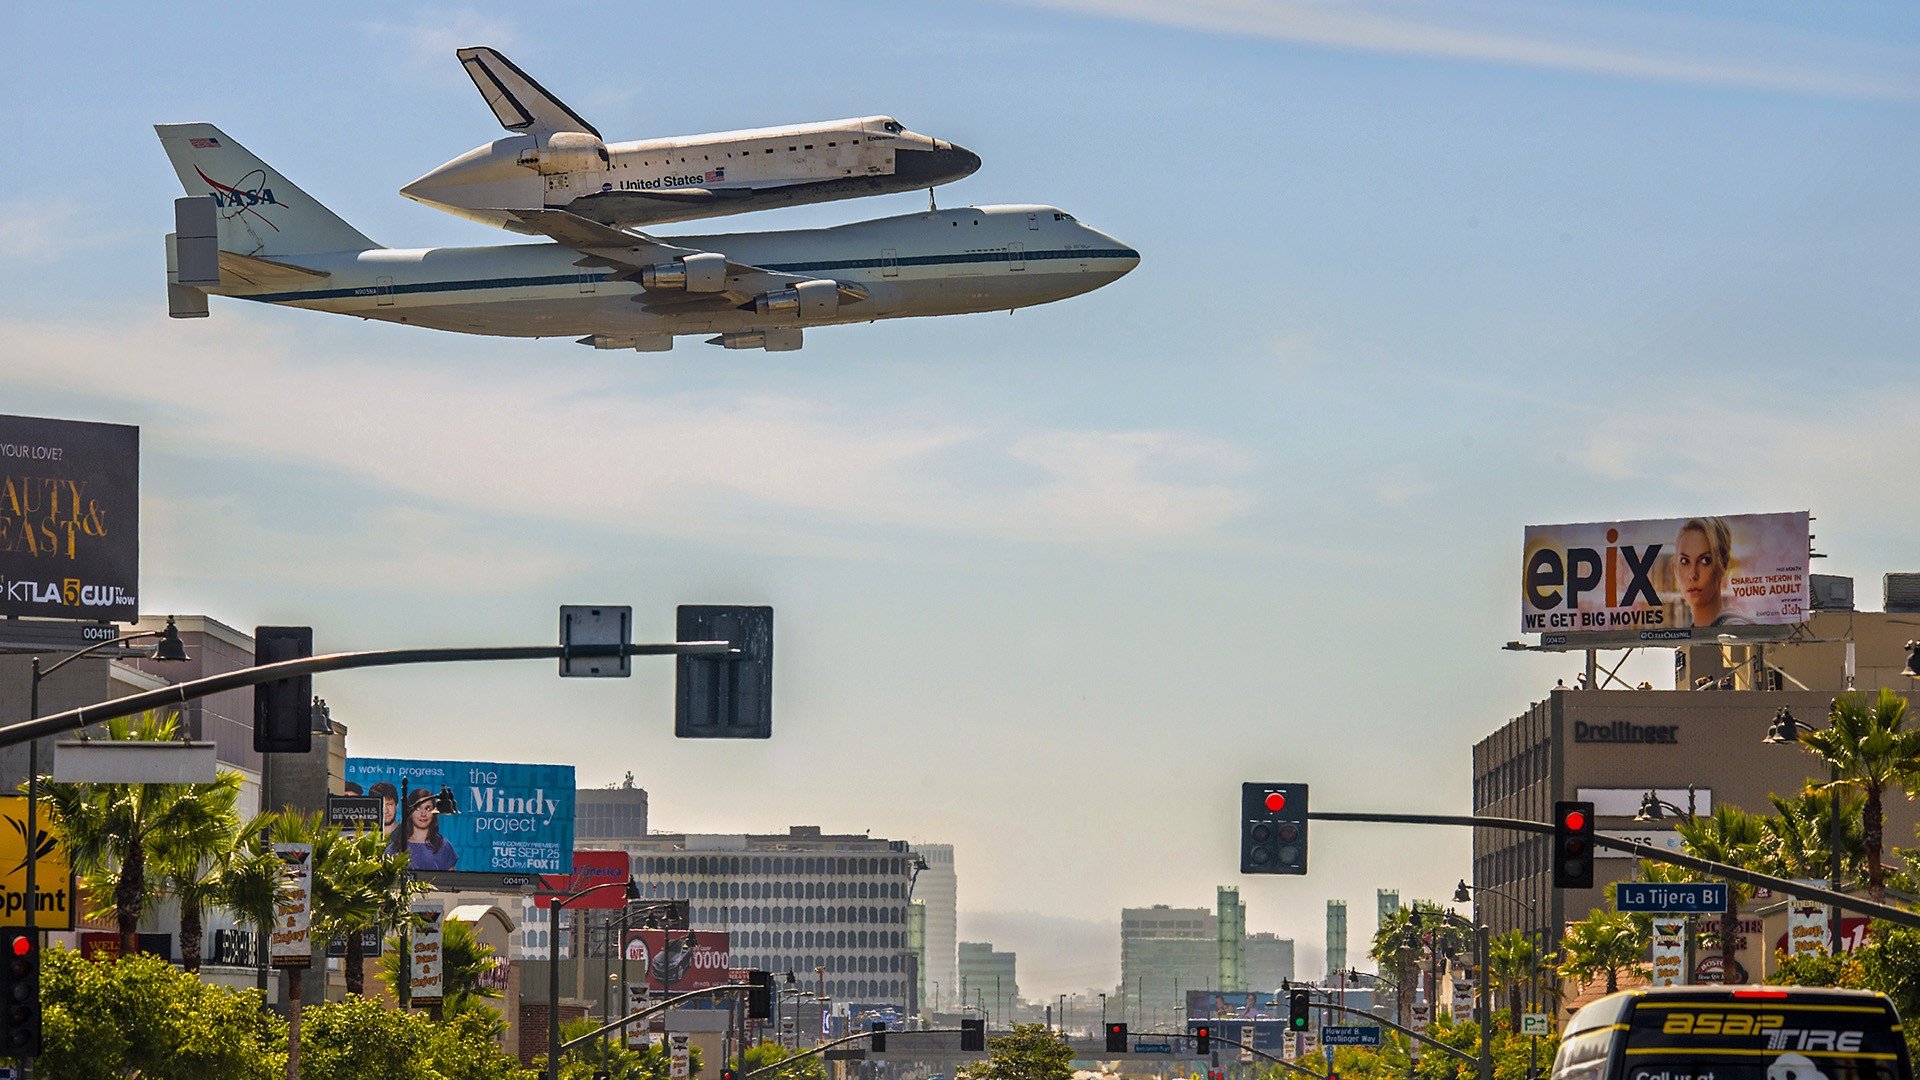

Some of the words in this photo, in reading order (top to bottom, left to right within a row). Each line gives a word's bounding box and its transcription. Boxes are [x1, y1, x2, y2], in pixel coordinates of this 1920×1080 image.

[620, 178, 661, 190] United
[663, 174, 704, 187] States
[209, 188, 276, 207] NASA
[0, 444, 29, 458] YOUR
[32, 446, 63, 460] LOVE?
[83, 499, 107, 536] &
[1731, 576, 1763, 584] CHARLIZE
[1765, 575, 1792, 583] THERON
[8, 581, 62, 603] KTLA
[64, 579, 79, 605] 5
[115, 587, 124, 595] TV
[1733, 586, 1766, 597] YOUNG
[1769, 584, 1801, 595] ADULT
[116, 596, 135, 605] NOW
[1782, 603, 1801, 615] dish
[1525, 614, 1546, 628] WE
[1550, 613, 1577, 627] GET
[1581, 611, 1605, 626] BIG
[1610, 610, 1664, 626] MOVIES
[84, 628, 115, 640] 004111
[1575, 721, 1679, 744] Drollinger
[349, 765, 356, 773] a
[359, 765, 383, 774] work
[387, 765, 396, 774] in
[399, 766, 445, 777] progress.
[469, 768, 497, 785] the
[468, 786, 560, 826] Mindy
[476, 815, 536, 835] project
[492, 847, 516, 857] TUE
[518, 847, 546, 858] SEPT
[547, 849, 560, 859] 25
[503, 877, 529, 885] 004110
[1625, 889, 1645, 904] La
[1649, 889, 1696, 909] Tijera
[630, 948, 644, 960] WE
[1325, 1035, 1360, 1043] Drollinger
[1361, 1035, 1376, 1043] Way
[1762, 1029, 1864, 1052] TIRE
